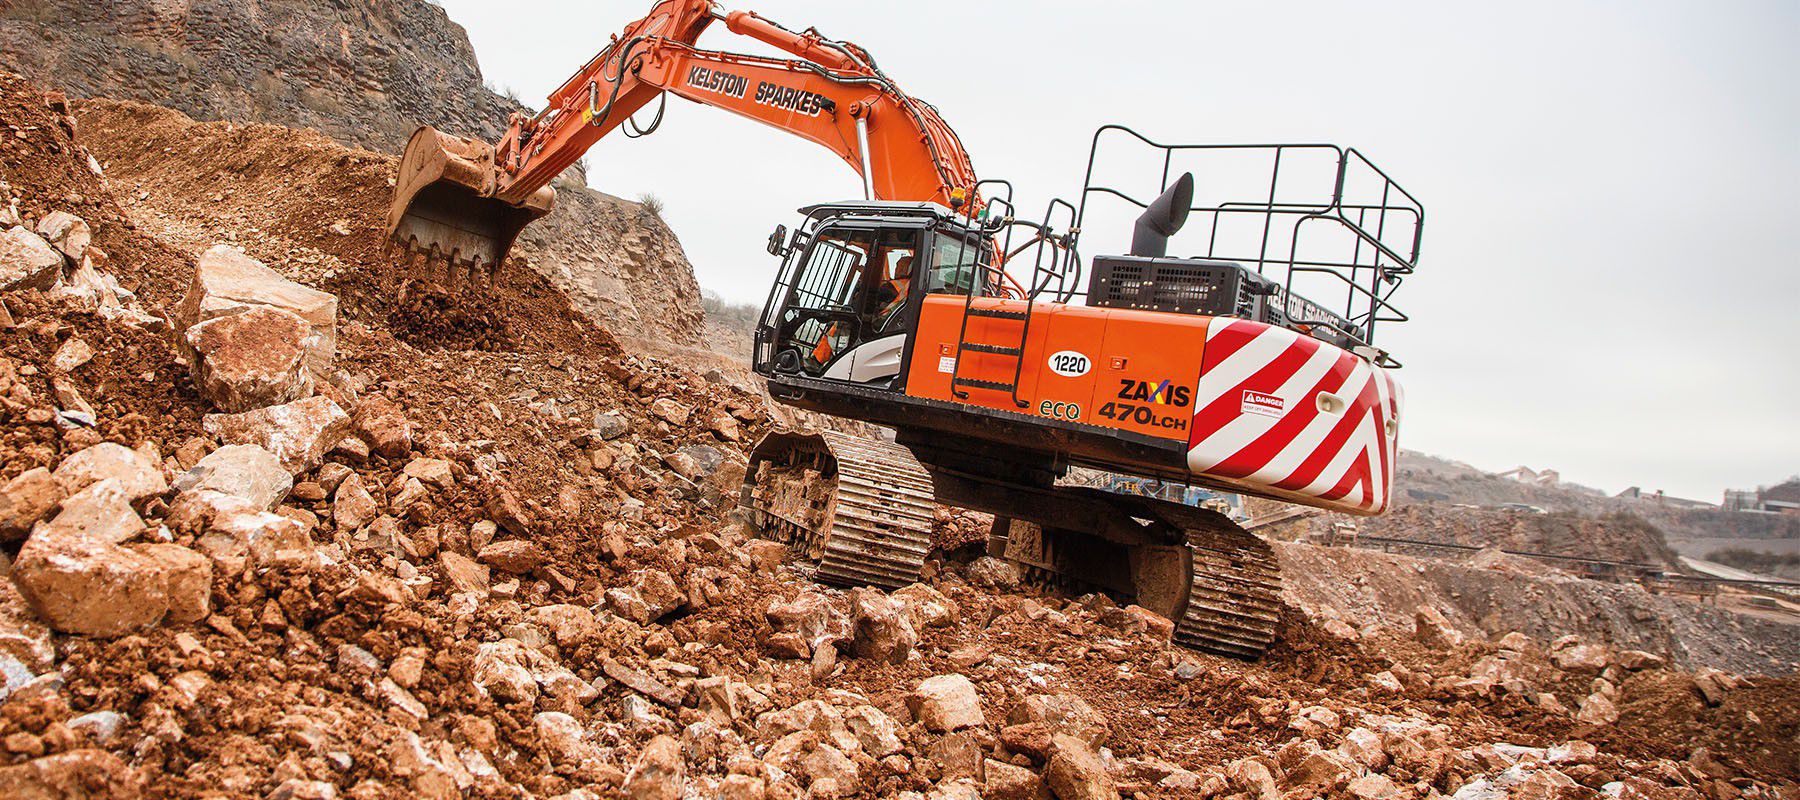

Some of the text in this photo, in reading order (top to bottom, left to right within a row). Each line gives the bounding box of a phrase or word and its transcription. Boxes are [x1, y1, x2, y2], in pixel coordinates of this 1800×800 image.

[687, 65, 822, 117] KELSTON SPARKES
[1266, 290, 1304, 321] KELTON
[1054, 355, 1086, 374] 1220
[1118, 379, 1190, 407] ZAXIS
[1255, 395, 1283, 406] DANGER
[1039, 400, 1080, 420] eco
[1098, 402, 1187, 431] 470LCH
